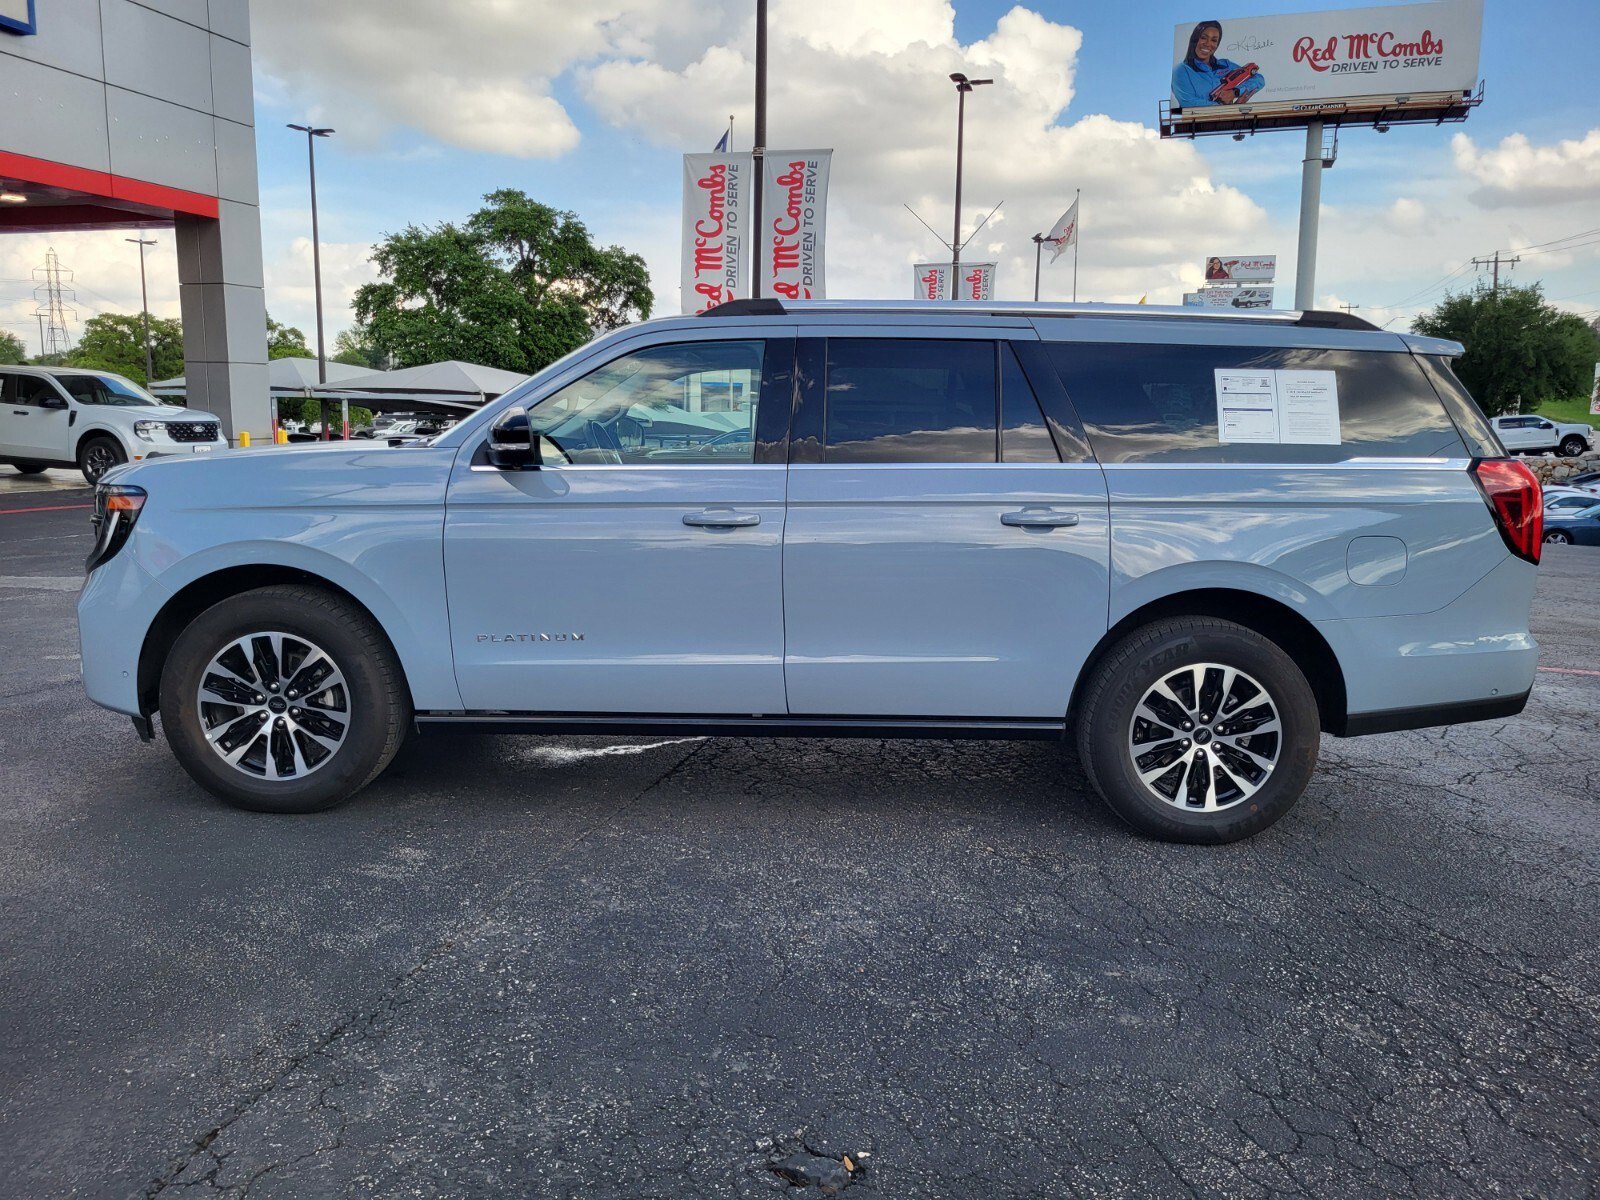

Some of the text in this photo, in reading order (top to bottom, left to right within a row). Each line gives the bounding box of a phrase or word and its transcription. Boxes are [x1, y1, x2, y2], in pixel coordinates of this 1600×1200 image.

[1293, 36, 1338, 72] Red
[1341, 29, 1443, 59] McCombs
[1331, 56, 1443, 73] DRIVEN TO SERVE
[695, 164, 726, 279] McCombs
[726, 164, 739, 288] DRIVEN TO SERVE
[773, 160, 805, 278] McCombs
[803, 160, 818, 286] DRIVEN TO SERVE
[477, 633, 585, 643] PLATINUM
